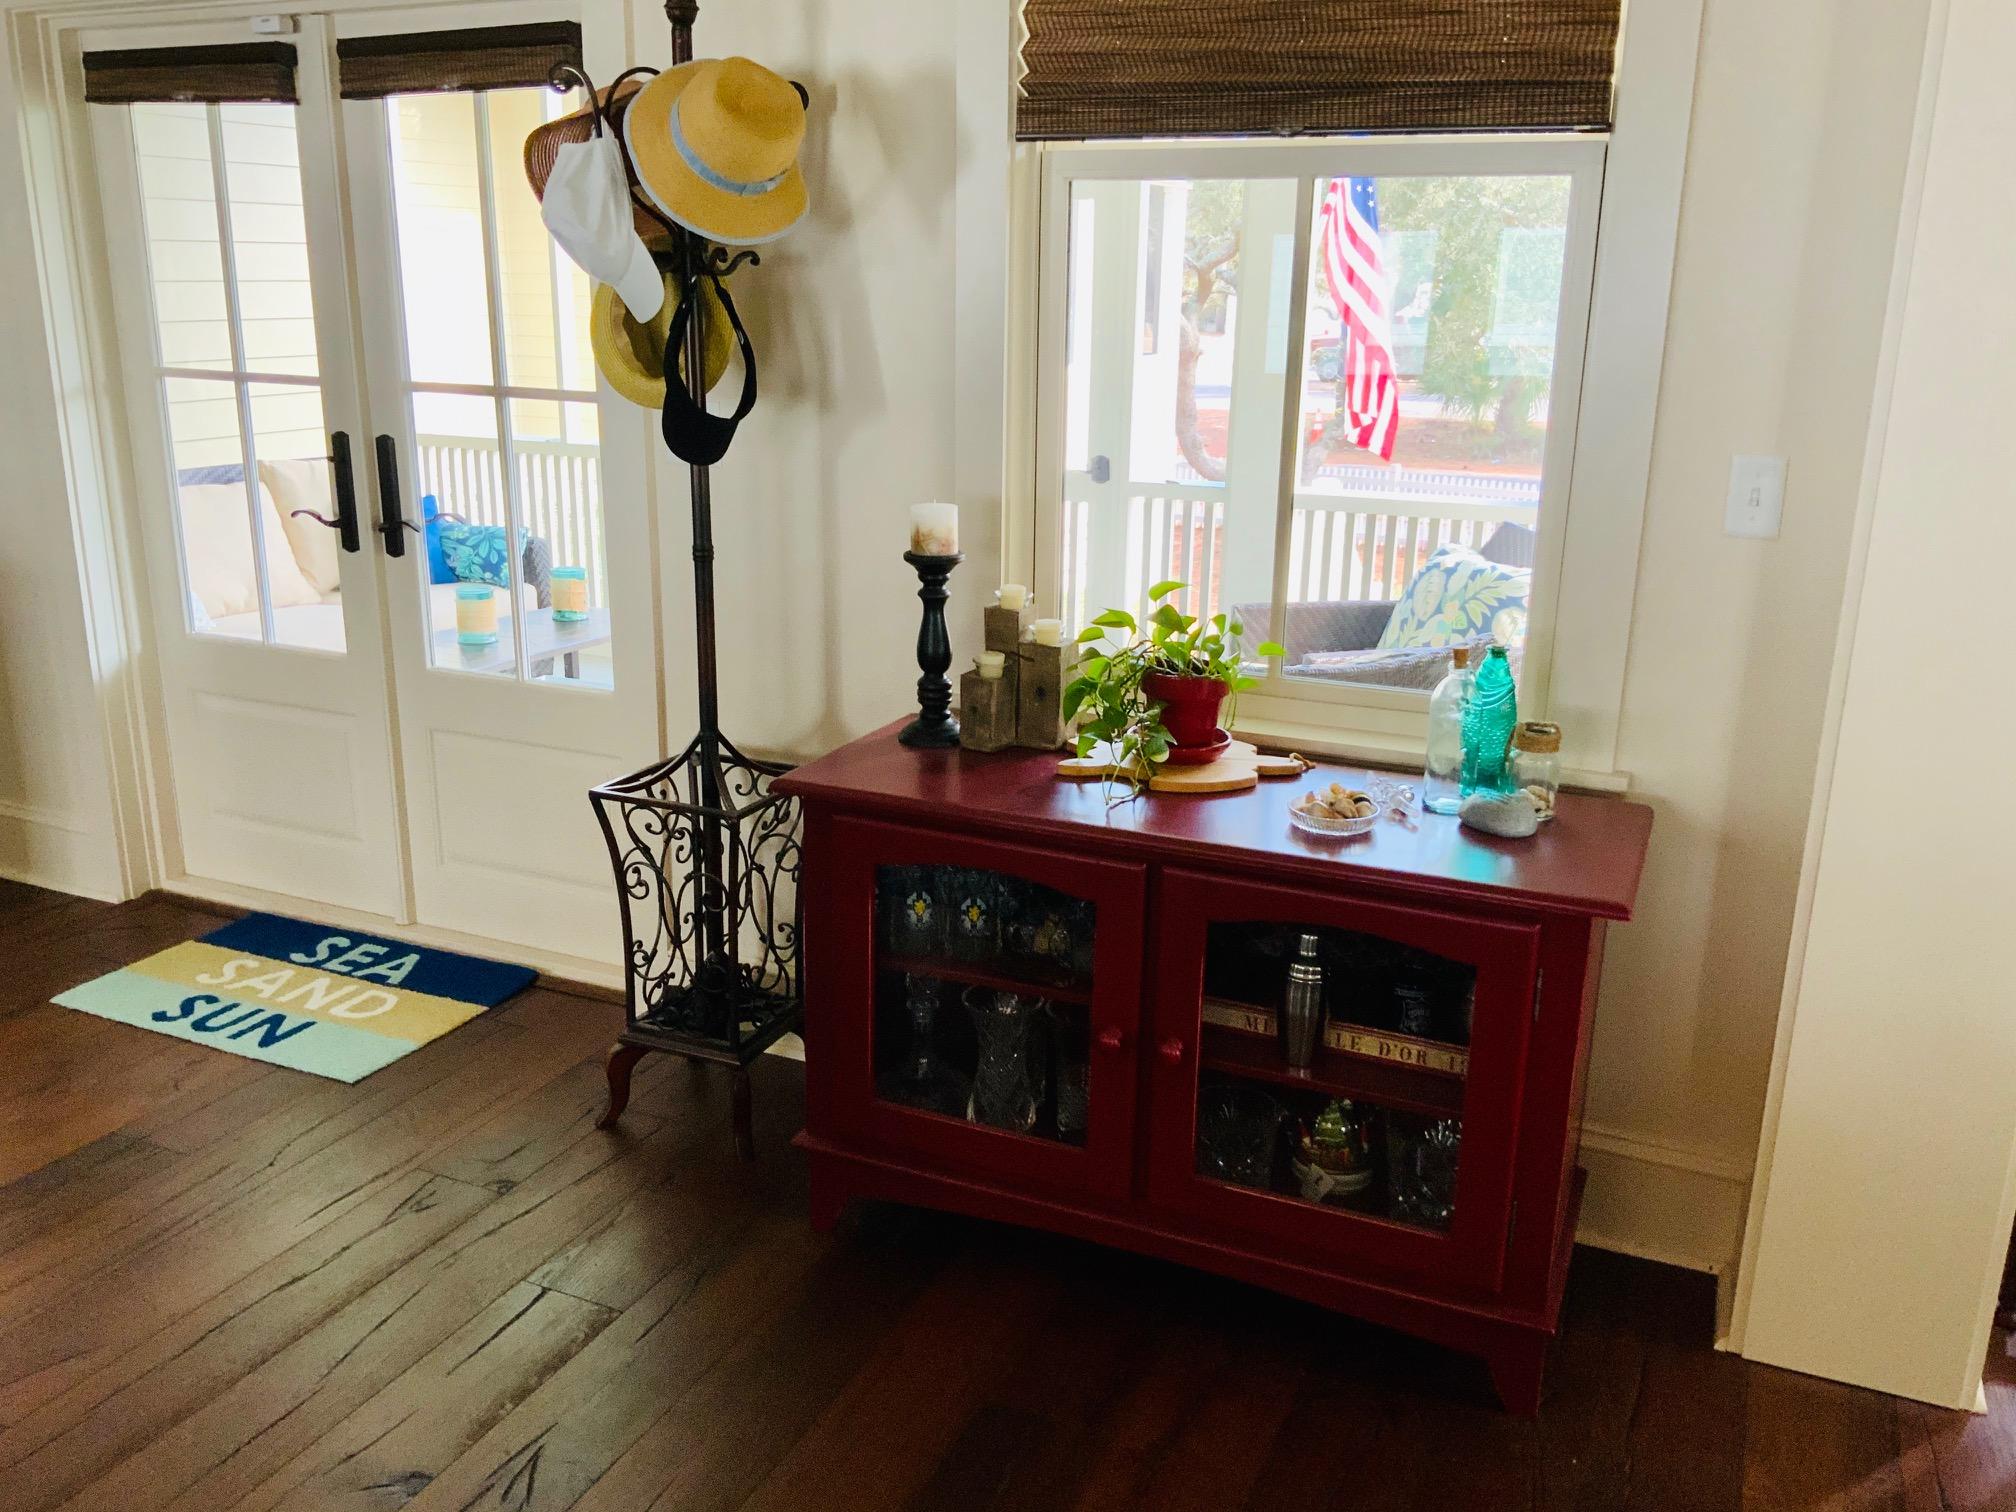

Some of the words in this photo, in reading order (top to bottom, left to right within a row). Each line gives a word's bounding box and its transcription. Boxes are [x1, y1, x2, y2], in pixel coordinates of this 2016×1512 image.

[289, 936, 421, 986] SEA
[195, 958, 400, 1020] SAND
[152, 994, 318, 1049] SUN
